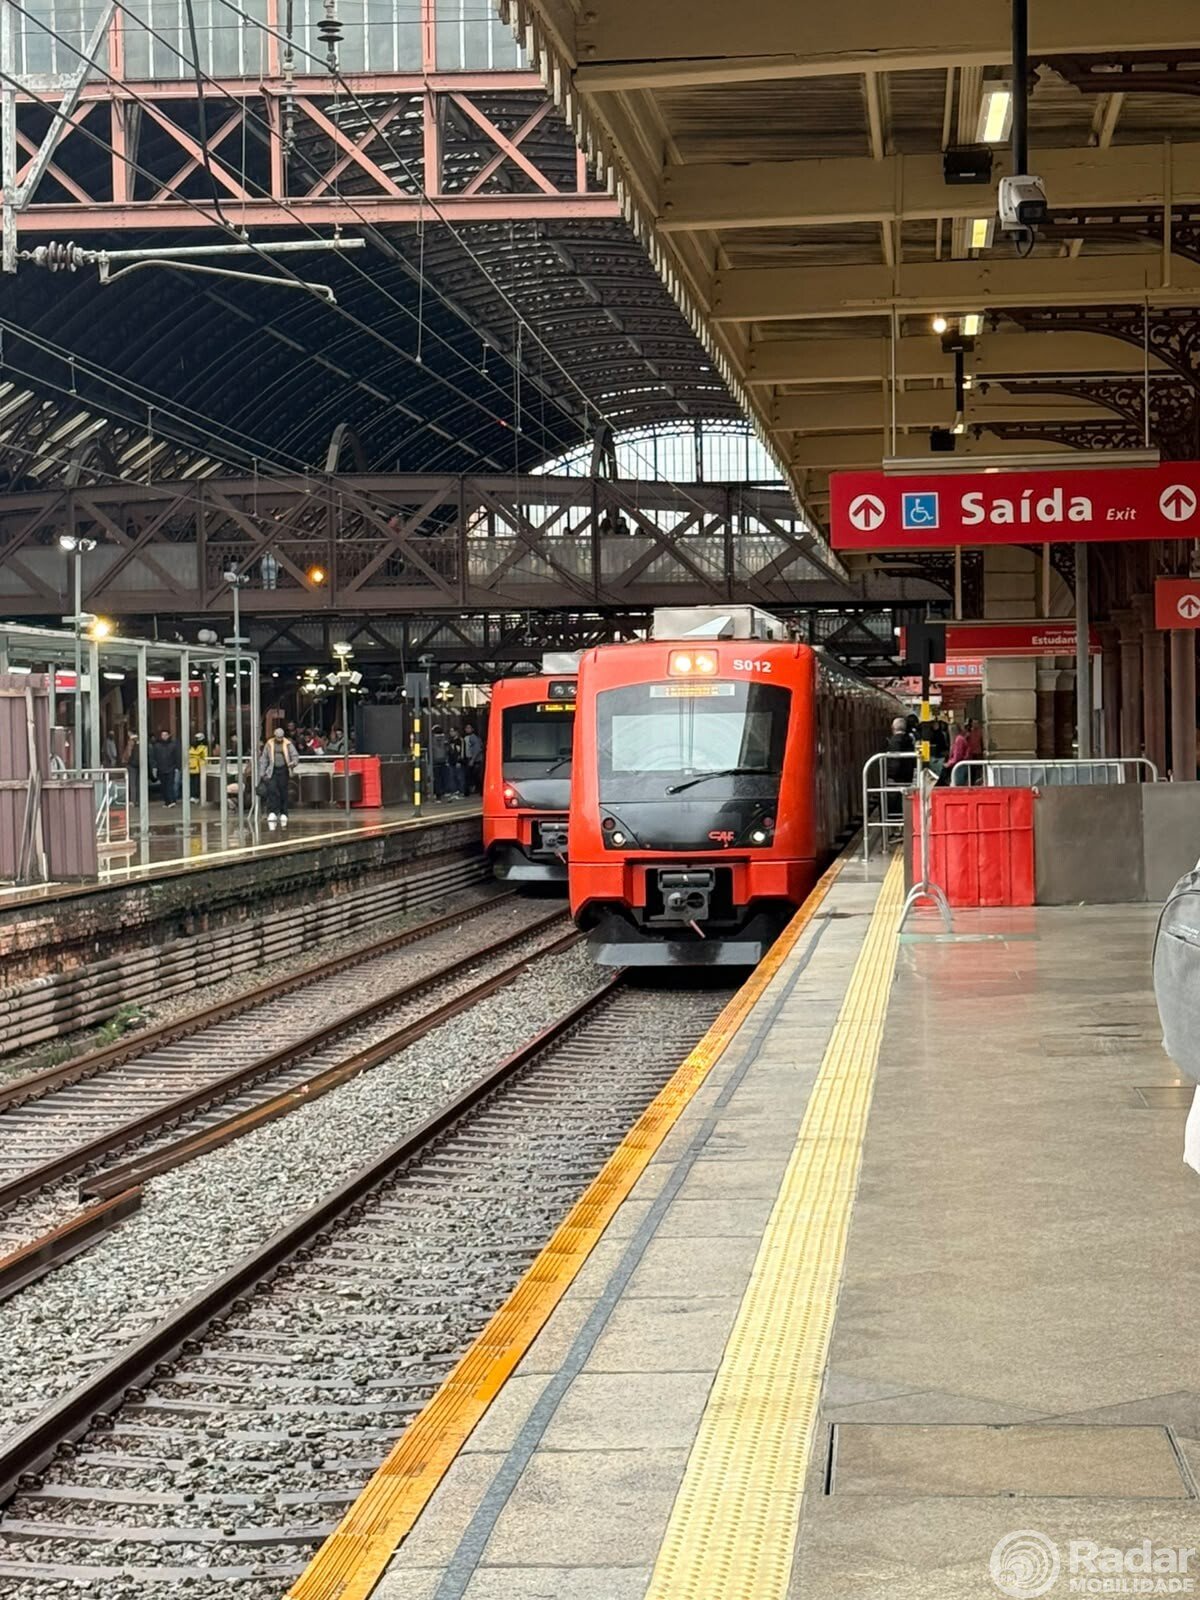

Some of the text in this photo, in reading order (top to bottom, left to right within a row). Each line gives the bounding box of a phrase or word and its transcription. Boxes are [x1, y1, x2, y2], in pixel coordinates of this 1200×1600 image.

[961, 487, 1137, 526] Saída Exit
[1032, 635, 1089, 645] Estudant
[733, 659, 772, 673] S012
[708, 831, 735, 843] CAF
